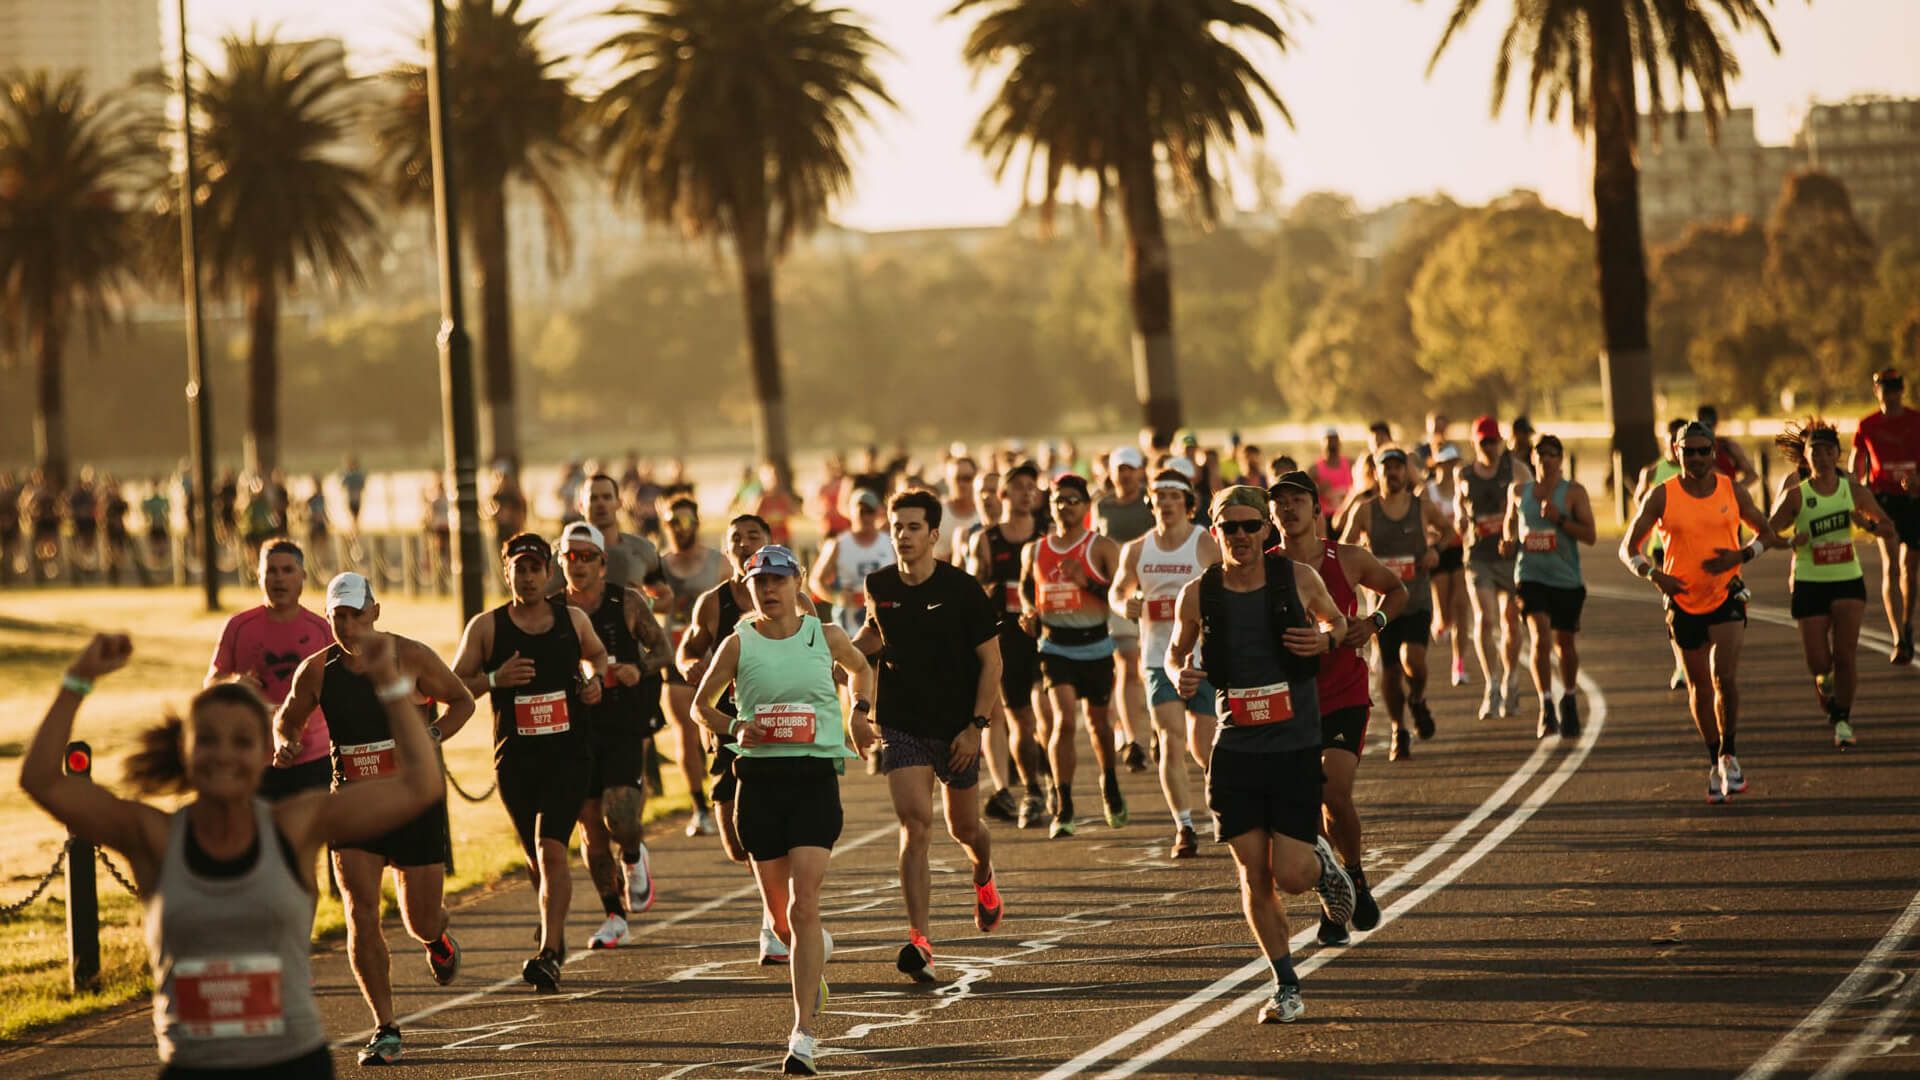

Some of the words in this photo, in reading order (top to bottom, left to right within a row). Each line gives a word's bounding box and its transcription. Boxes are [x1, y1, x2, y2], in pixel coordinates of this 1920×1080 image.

[530, 704, 553, 715] AARON
[761, 716, 776, 728] MRS
[777, 715, 808, 728] CHUBBS
[360, 764, 379, 776] 2219
